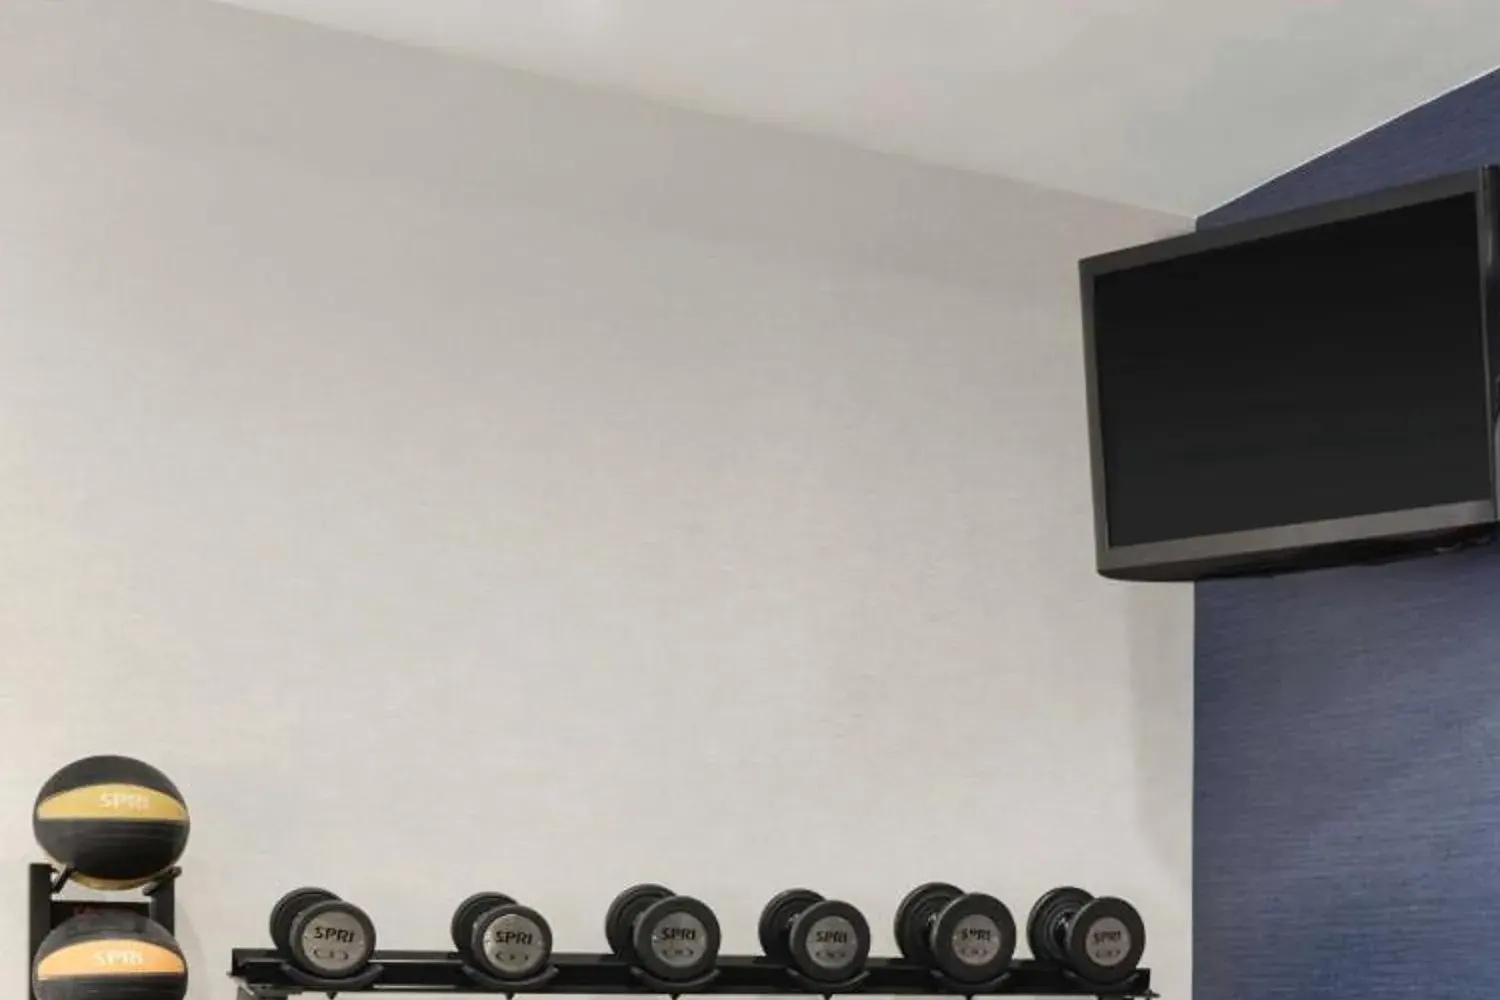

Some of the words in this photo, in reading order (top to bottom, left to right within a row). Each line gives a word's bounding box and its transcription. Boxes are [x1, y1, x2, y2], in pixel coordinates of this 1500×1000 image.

[314, 926, 354, 943] SPRI
[496, 930, 533, 945] SPRI
[661, 927, 696, 941] SPRI
[816, 930, 848, 944] SPRI
